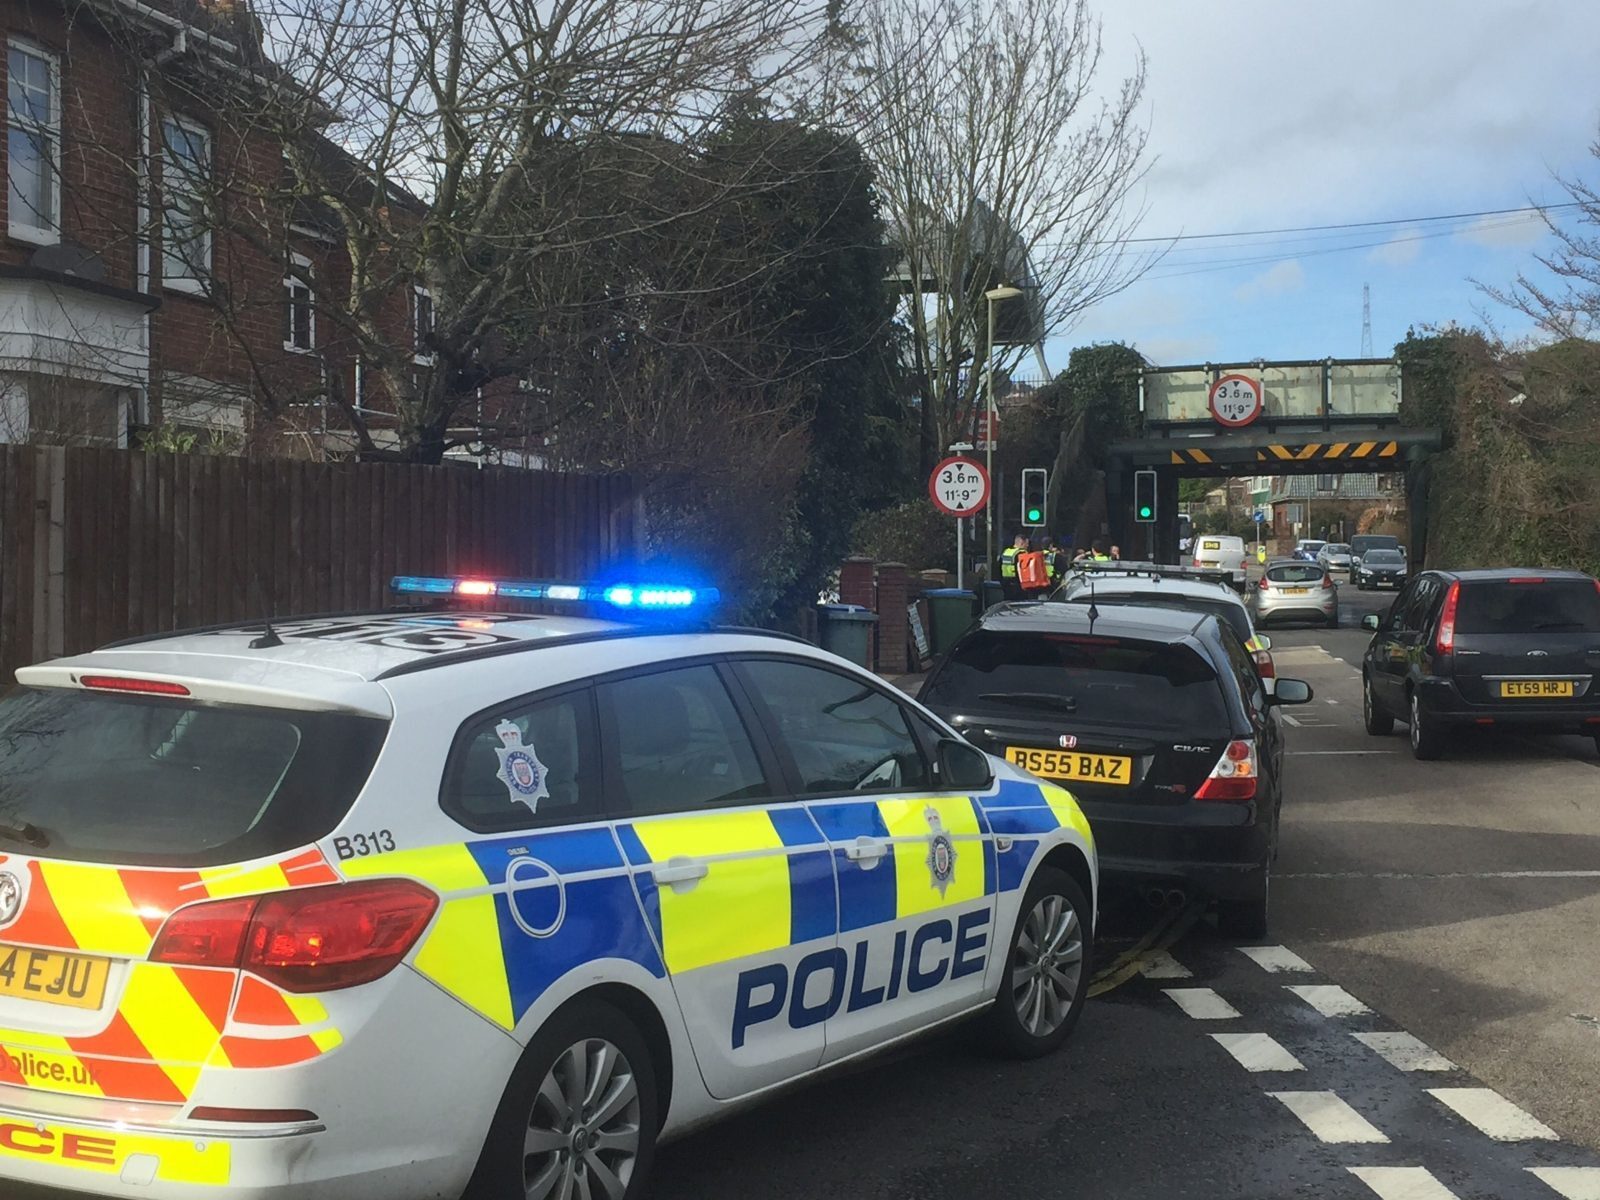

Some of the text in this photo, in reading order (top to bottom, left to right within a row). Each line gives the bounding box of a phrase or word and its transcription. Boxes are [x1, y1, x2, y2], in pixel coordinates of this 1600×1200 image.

[1507, 682, 1540, 695] ET59
[1015, 750, 1123, 779] BS55 BAZ
[333, 829, 396, 860] B313
[24, 951, 92, 998] EJU
[732, 907, 991, 1050] POLICE
